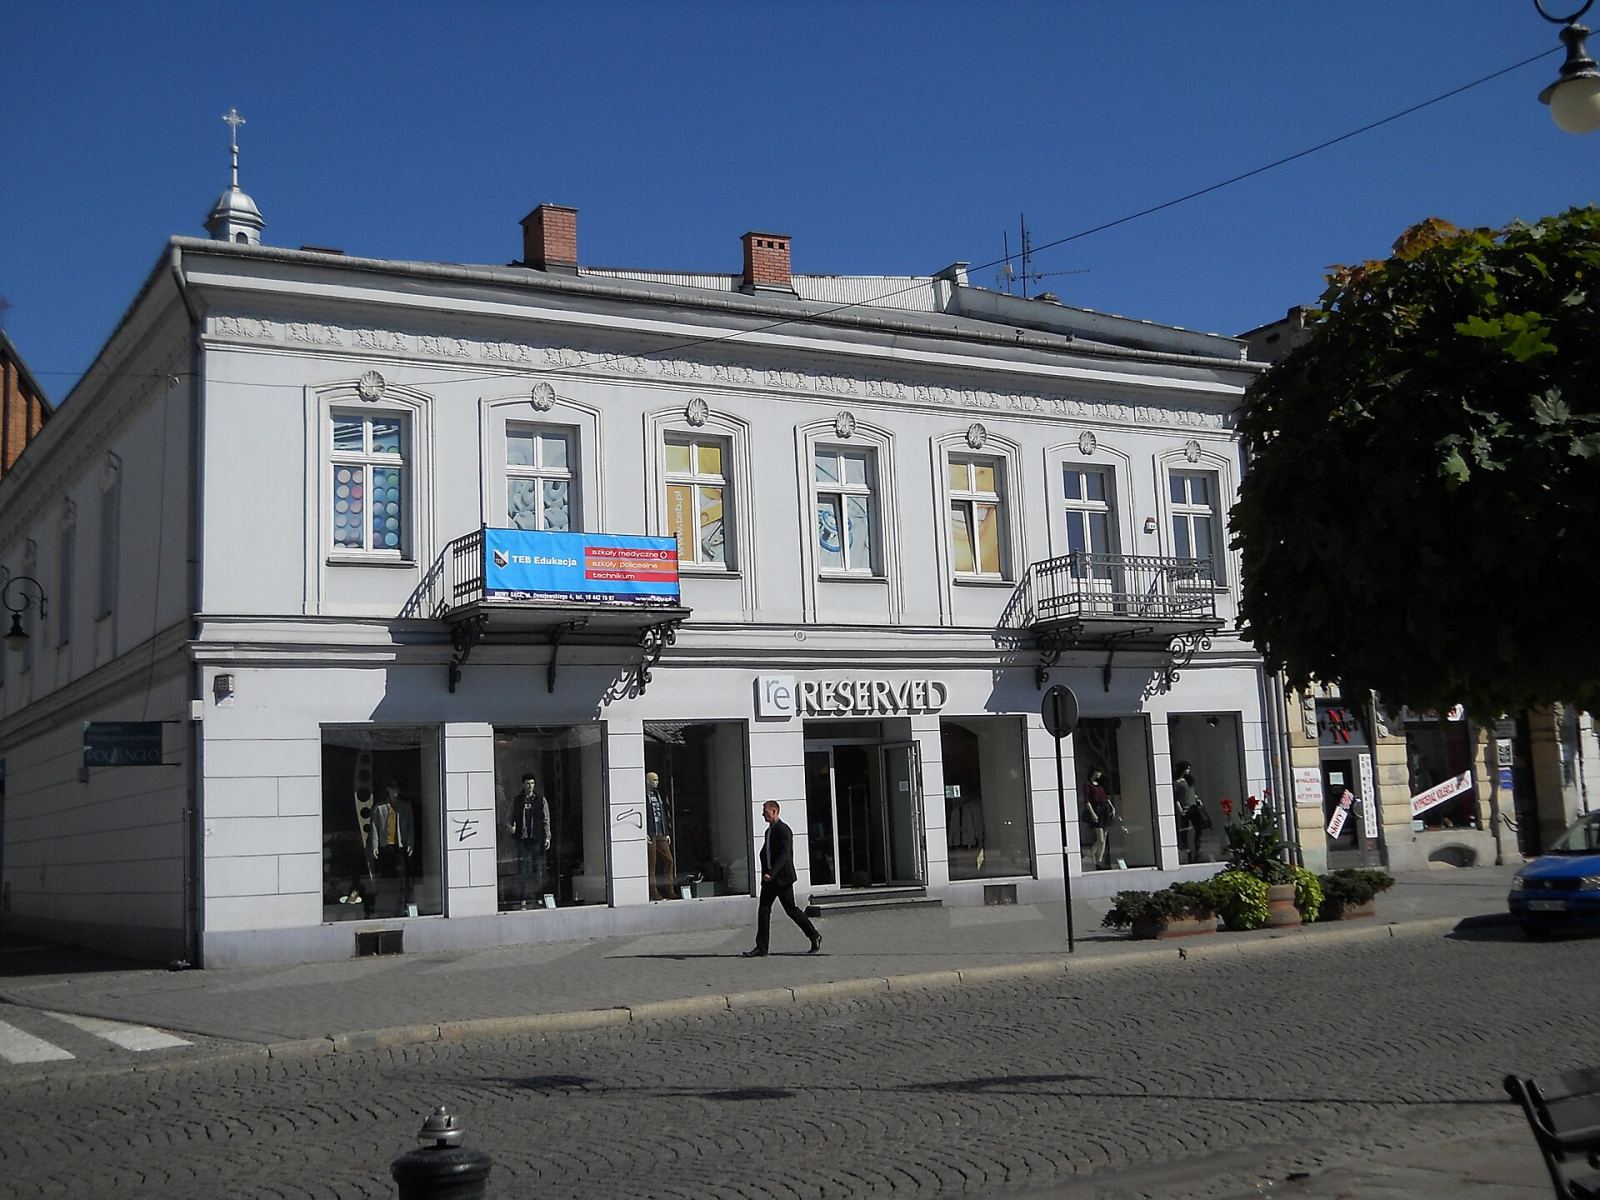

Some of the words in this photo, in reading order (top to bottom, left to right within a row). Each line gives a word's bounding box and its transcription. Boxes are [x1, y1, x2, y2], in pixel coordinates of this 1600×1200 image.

[618, 551, 659, 559] medyczne
[511, 555, 532, 564] TEB
[533, 556, 578, 567] Edukacja
[619, 562, 658, 570] policealne
[592, 572, 636, 580] technikum
[766, 679, 790, 711] re
[797, 680, 948, 715] RESERVED
